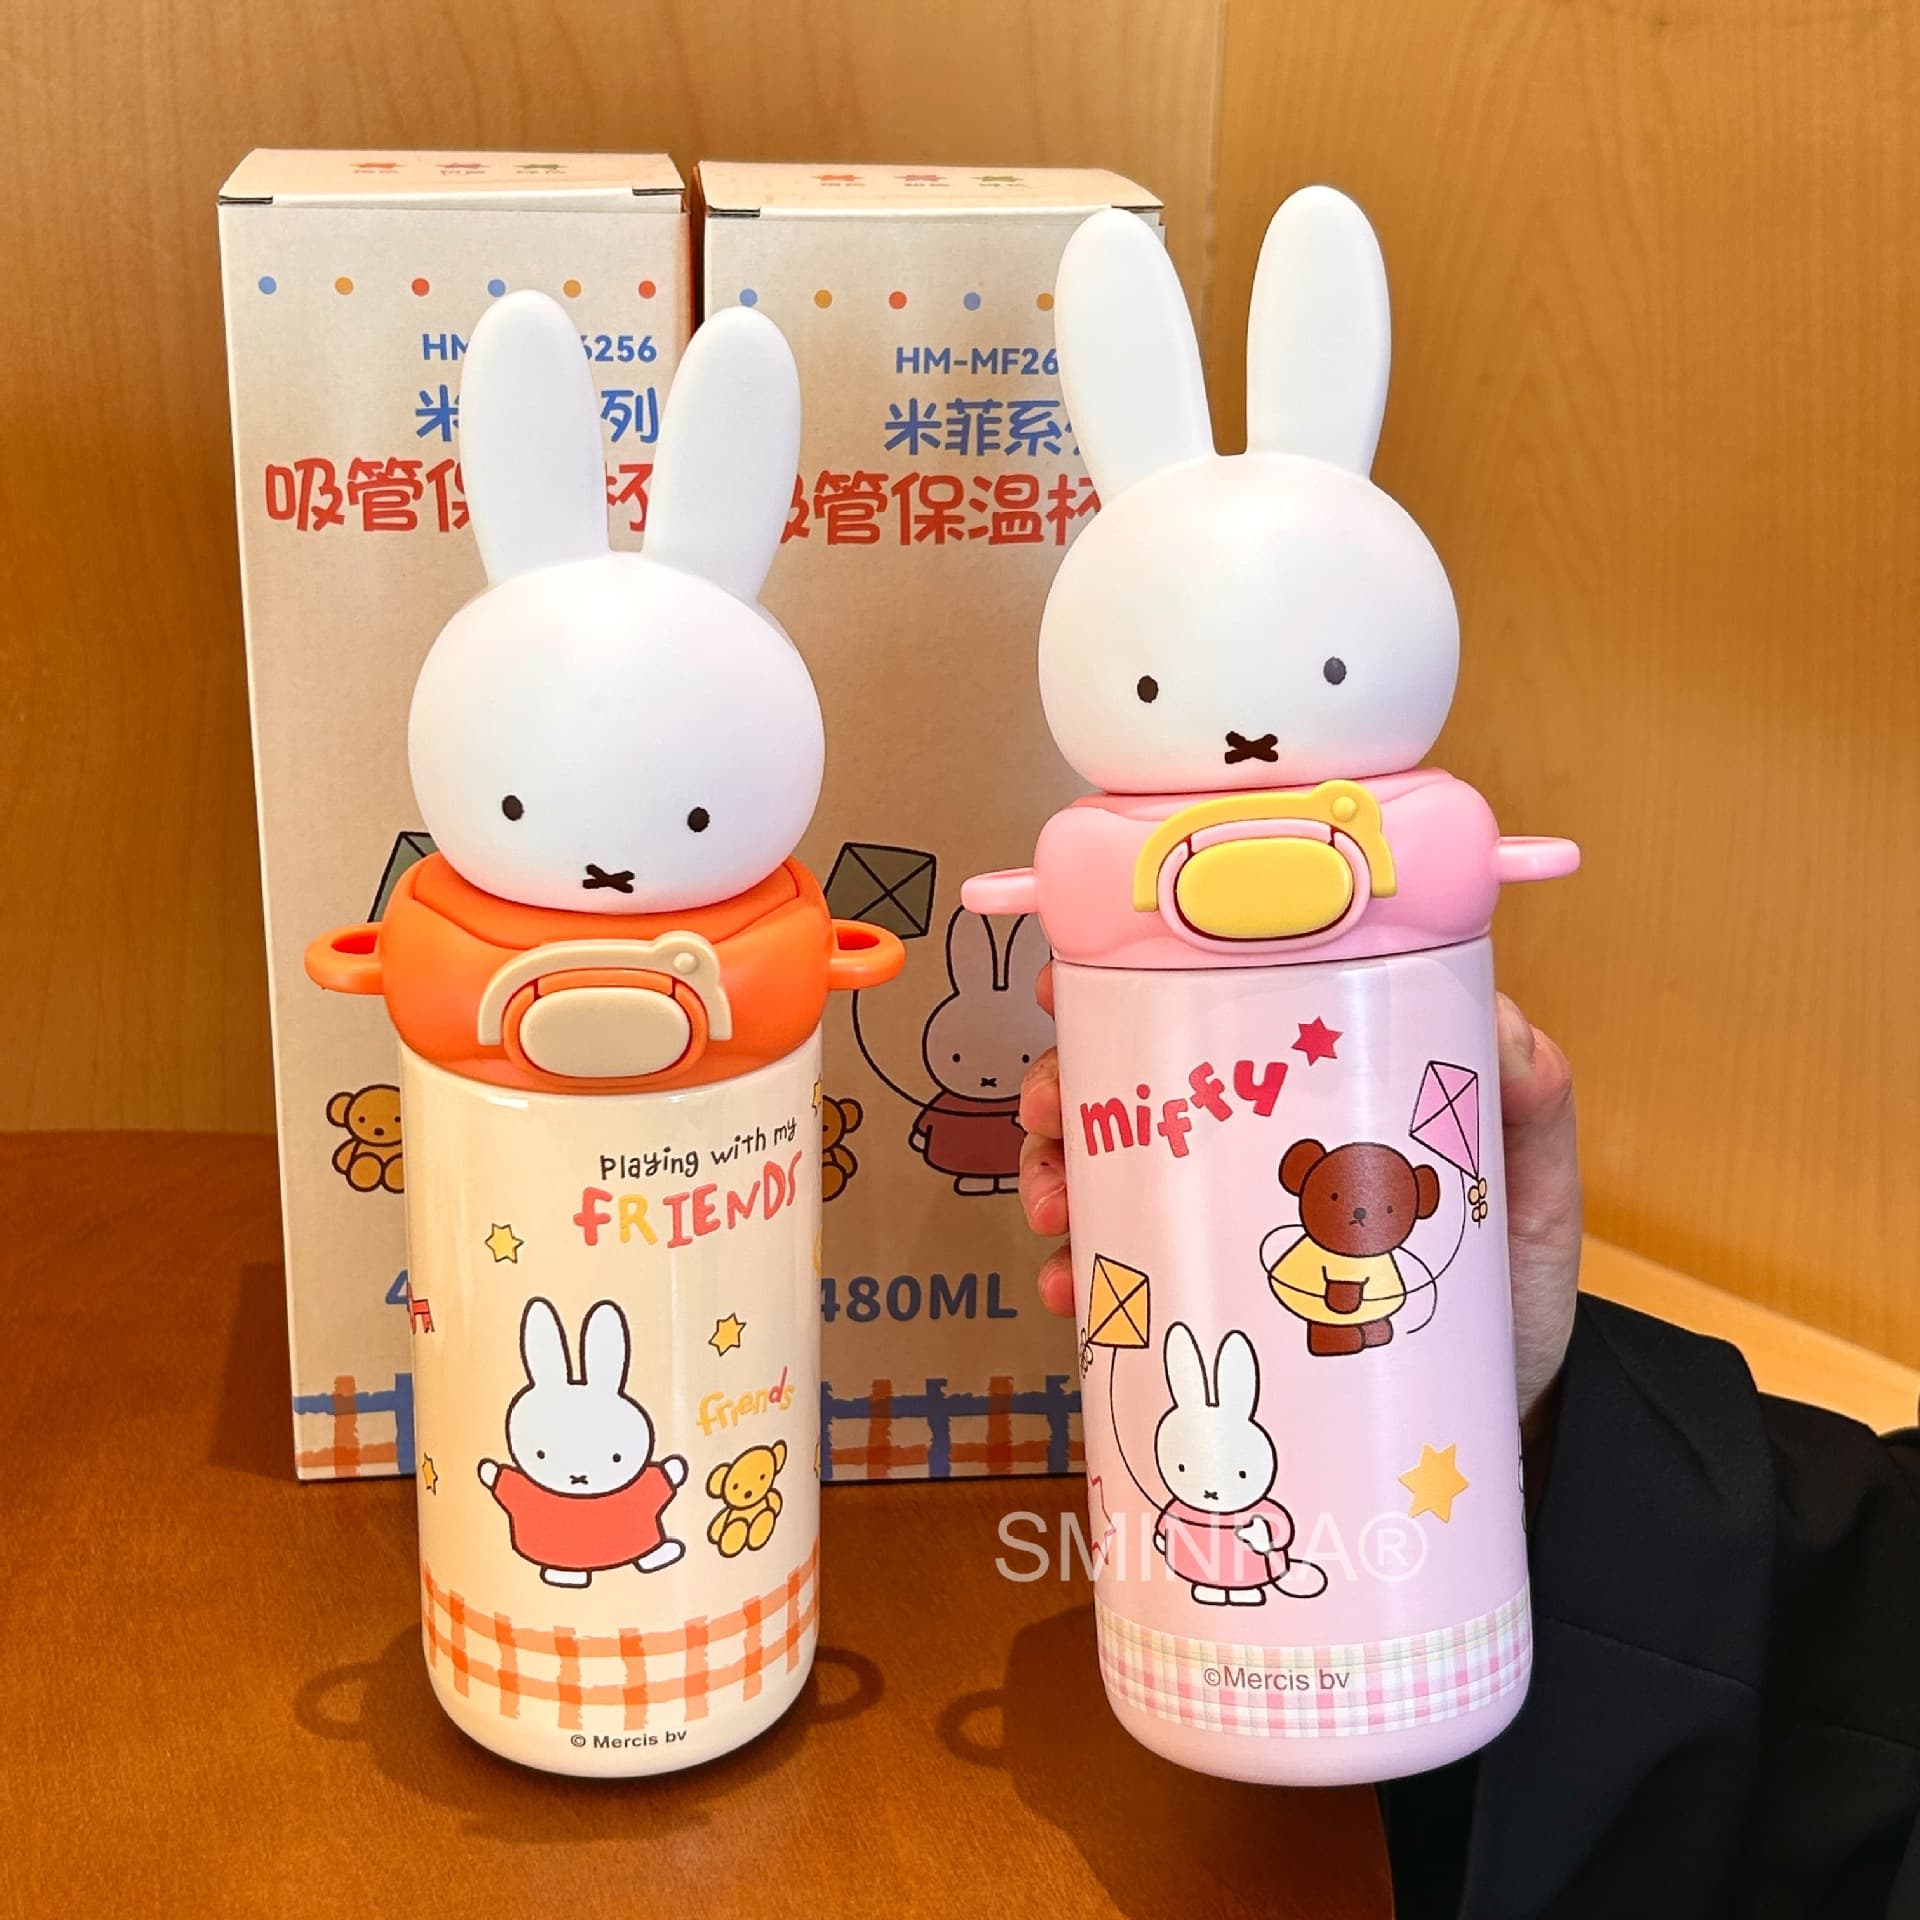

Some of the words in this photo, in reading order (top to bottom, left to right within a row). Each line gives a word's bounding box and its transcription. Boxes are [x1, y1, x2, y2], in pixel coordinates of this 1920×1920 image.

[415, 384, 660, 443] 米列
[884, 398, 1080, 456] 米菲系
[1080, 1060, 1288, 1158] miffy
[711, 1127, 767, 1165] with
[774, 1117, 797, 1146] my
[1319, 1669, 1350, 1690] bv
[593, 1733, 658, 1748] Mercis
[665, 1730, 687, 1743] bv
